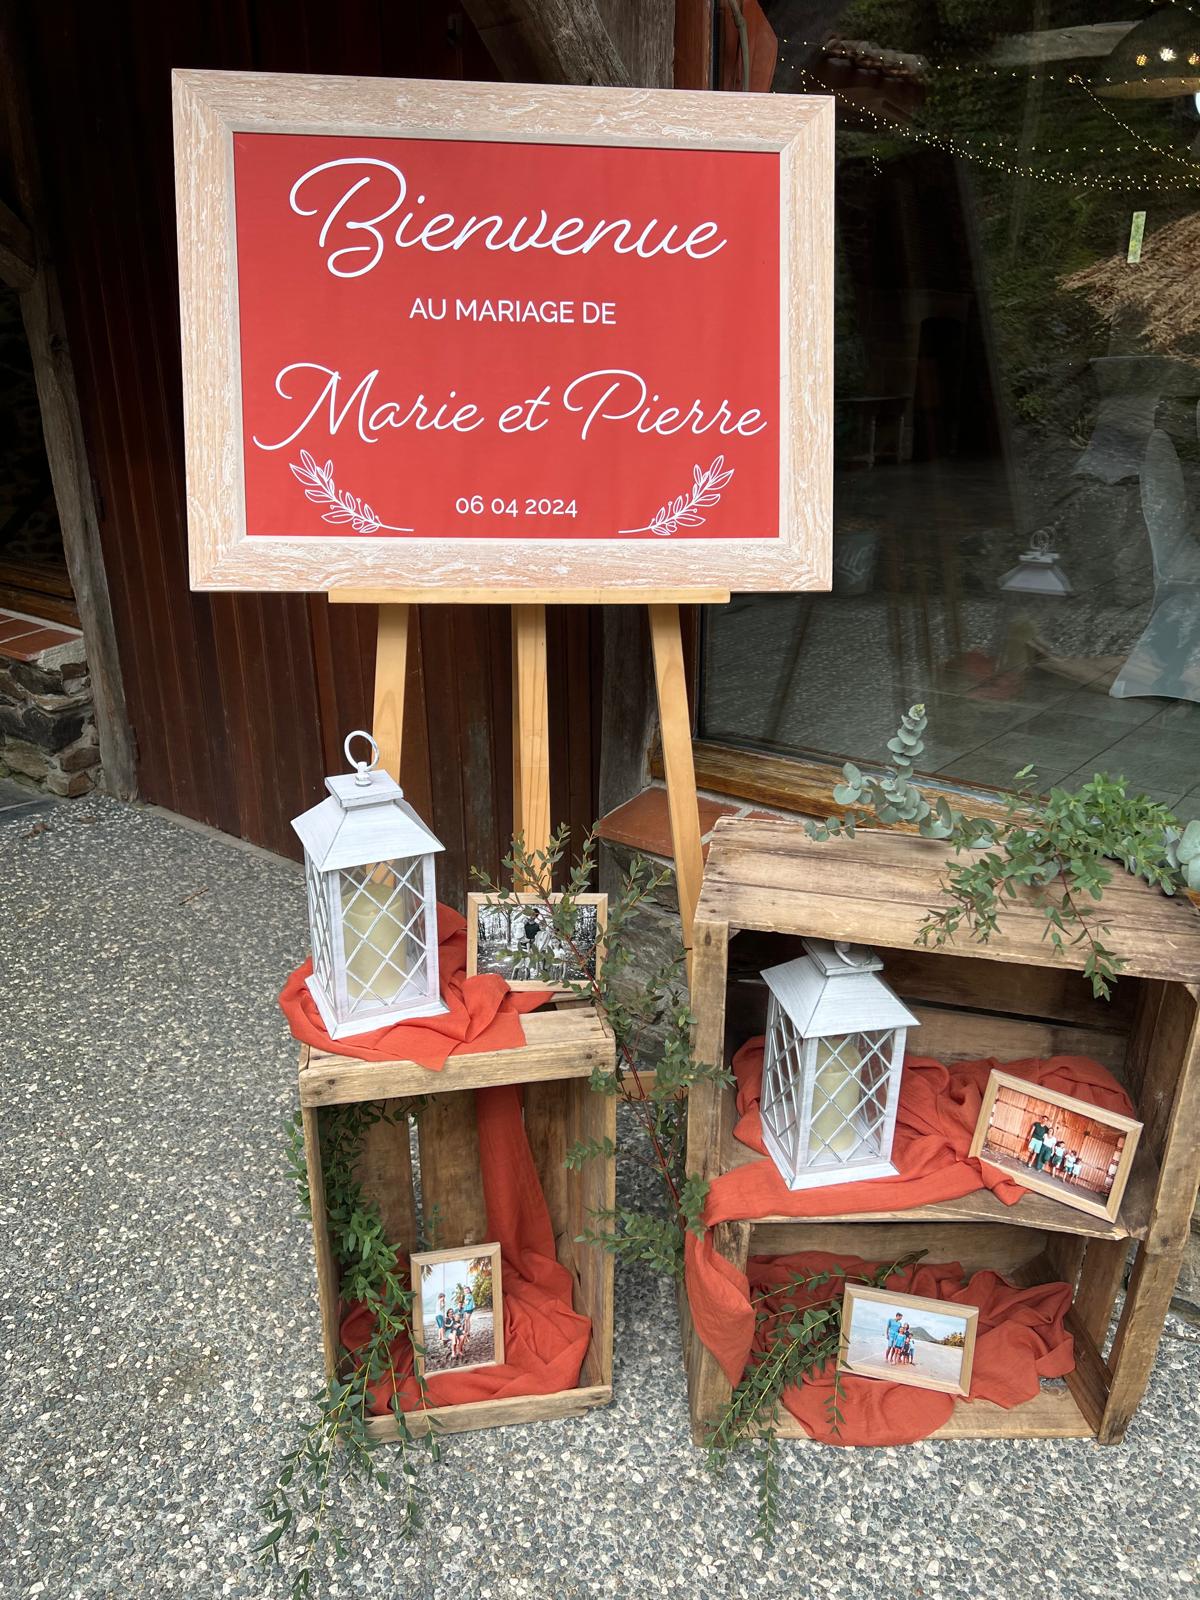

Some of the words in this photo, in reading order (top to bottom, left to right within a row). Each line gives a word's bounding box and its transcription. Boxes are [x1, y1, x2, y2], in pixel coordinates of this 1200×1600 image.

[289, 157, 728, 279] Bienvenue
[409, 297, 447, 321] AU
[455, 298, 575, 324] MARIAGE
[582, 301, 617, 325] DE
[252, 362, 485, 451] Marie
[498, 385, 551, 434] et
[562, 369, 768, 441] Pierre
[455, 494, 485, 515] 06
[490, 497, 519, 518] 04
[524, 498, 578, 518] 2024
